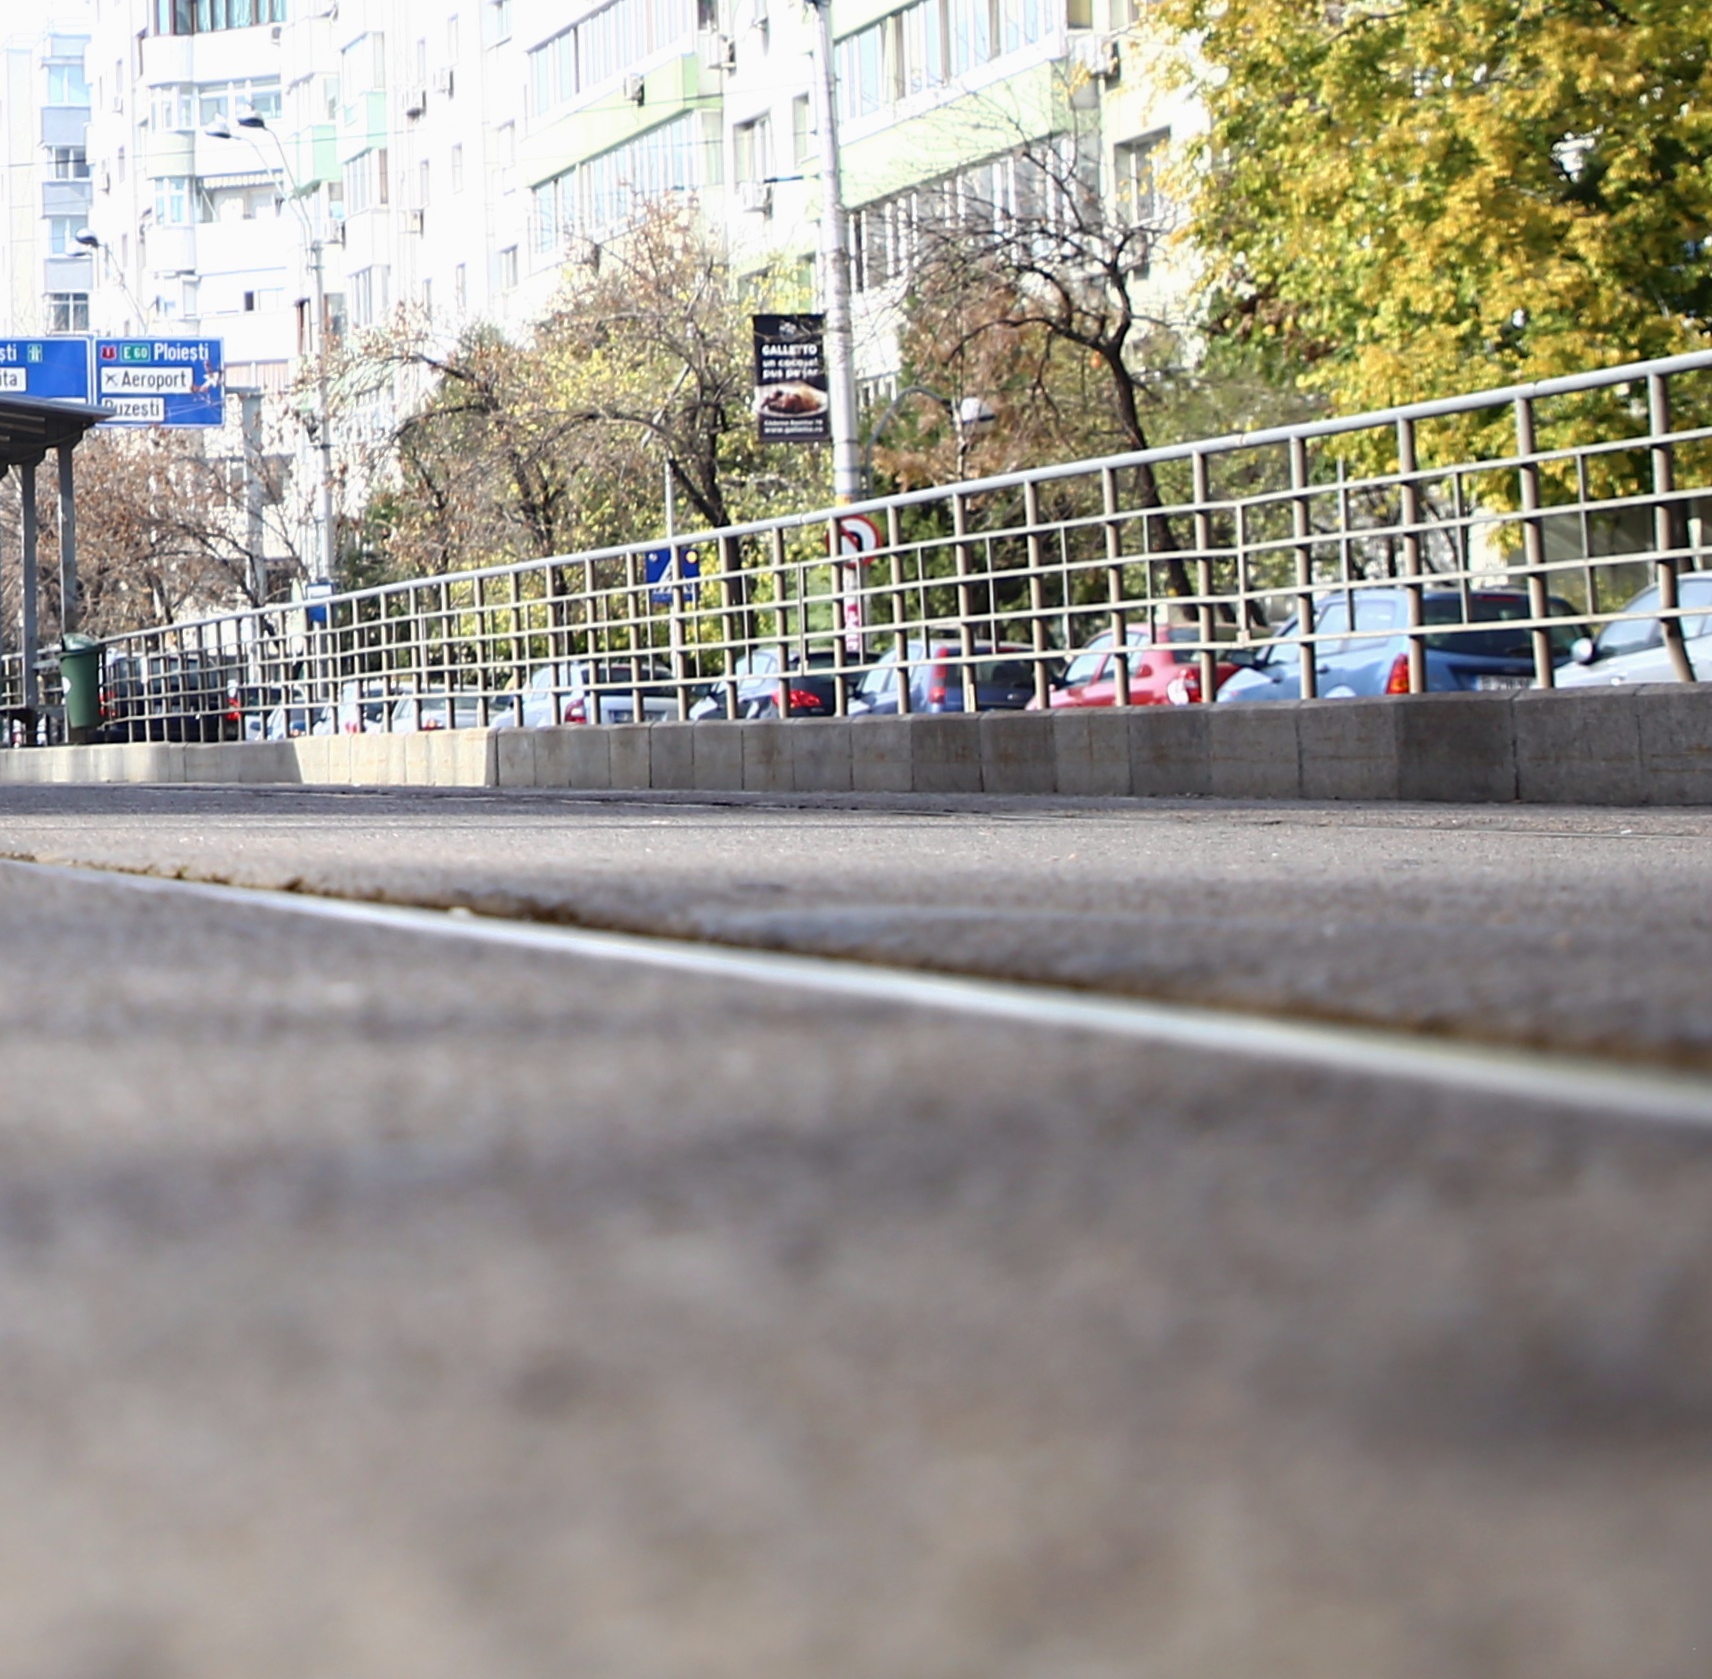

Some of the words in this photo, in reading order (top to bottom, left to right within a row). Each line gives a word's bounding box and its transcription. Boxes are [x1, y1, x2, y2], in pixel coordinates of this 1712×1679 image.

[123, 346, 132, 360] E
[133, 346, 148, 360] 60
[153, 342, 210, 363] Ploiești
[762, 344, 818, 356] GALLETTO
[121, 369, 187, 392] Aeroport
